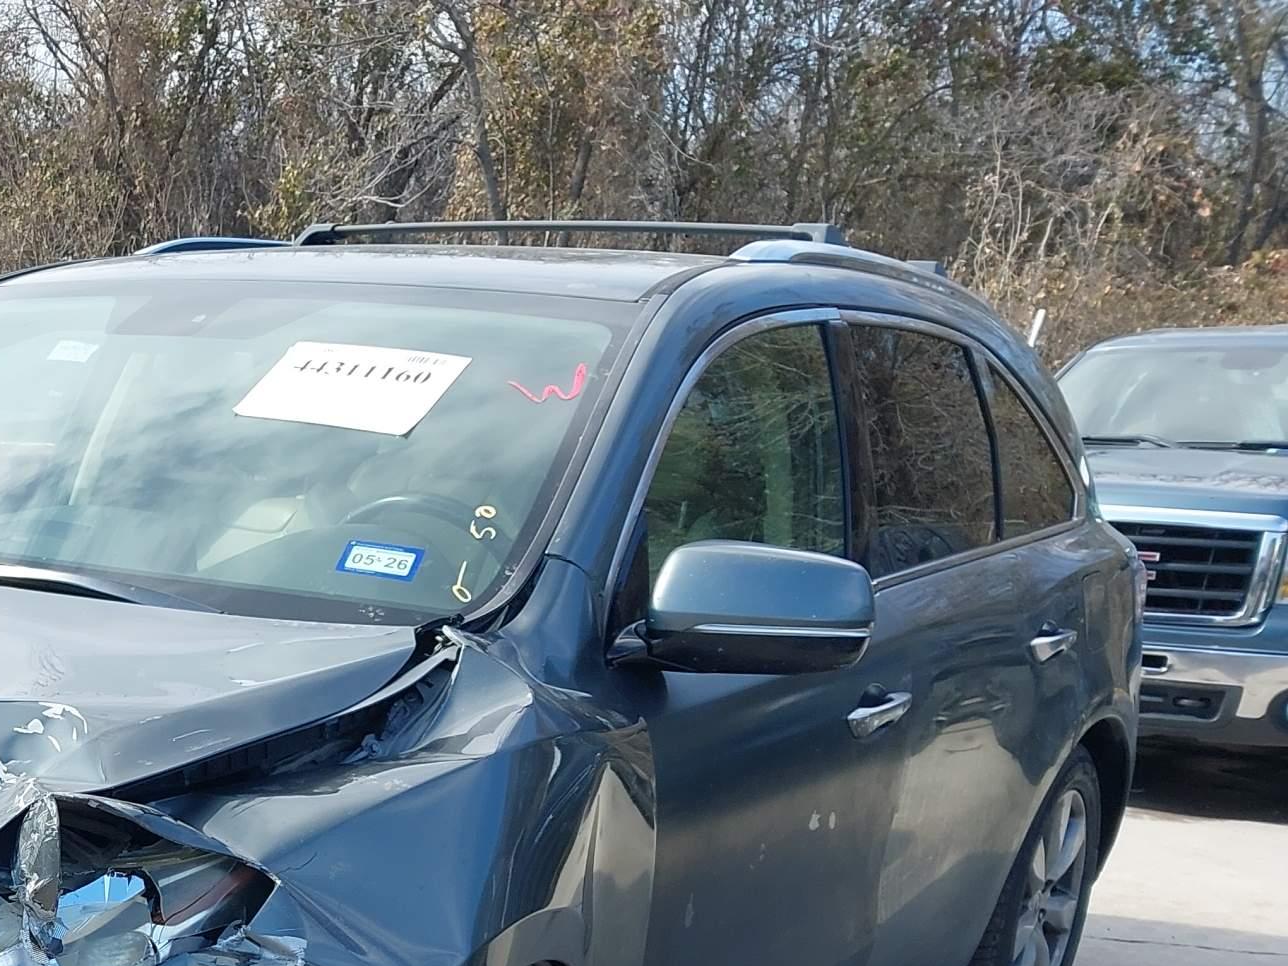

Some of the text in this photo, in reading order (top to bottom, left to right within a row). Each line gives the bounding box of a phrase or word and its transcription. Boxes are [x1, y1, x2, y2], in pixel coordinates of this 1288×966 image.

[293, 359, 432, 384] 44311160
[351, 552, 410, 571] 05 26
